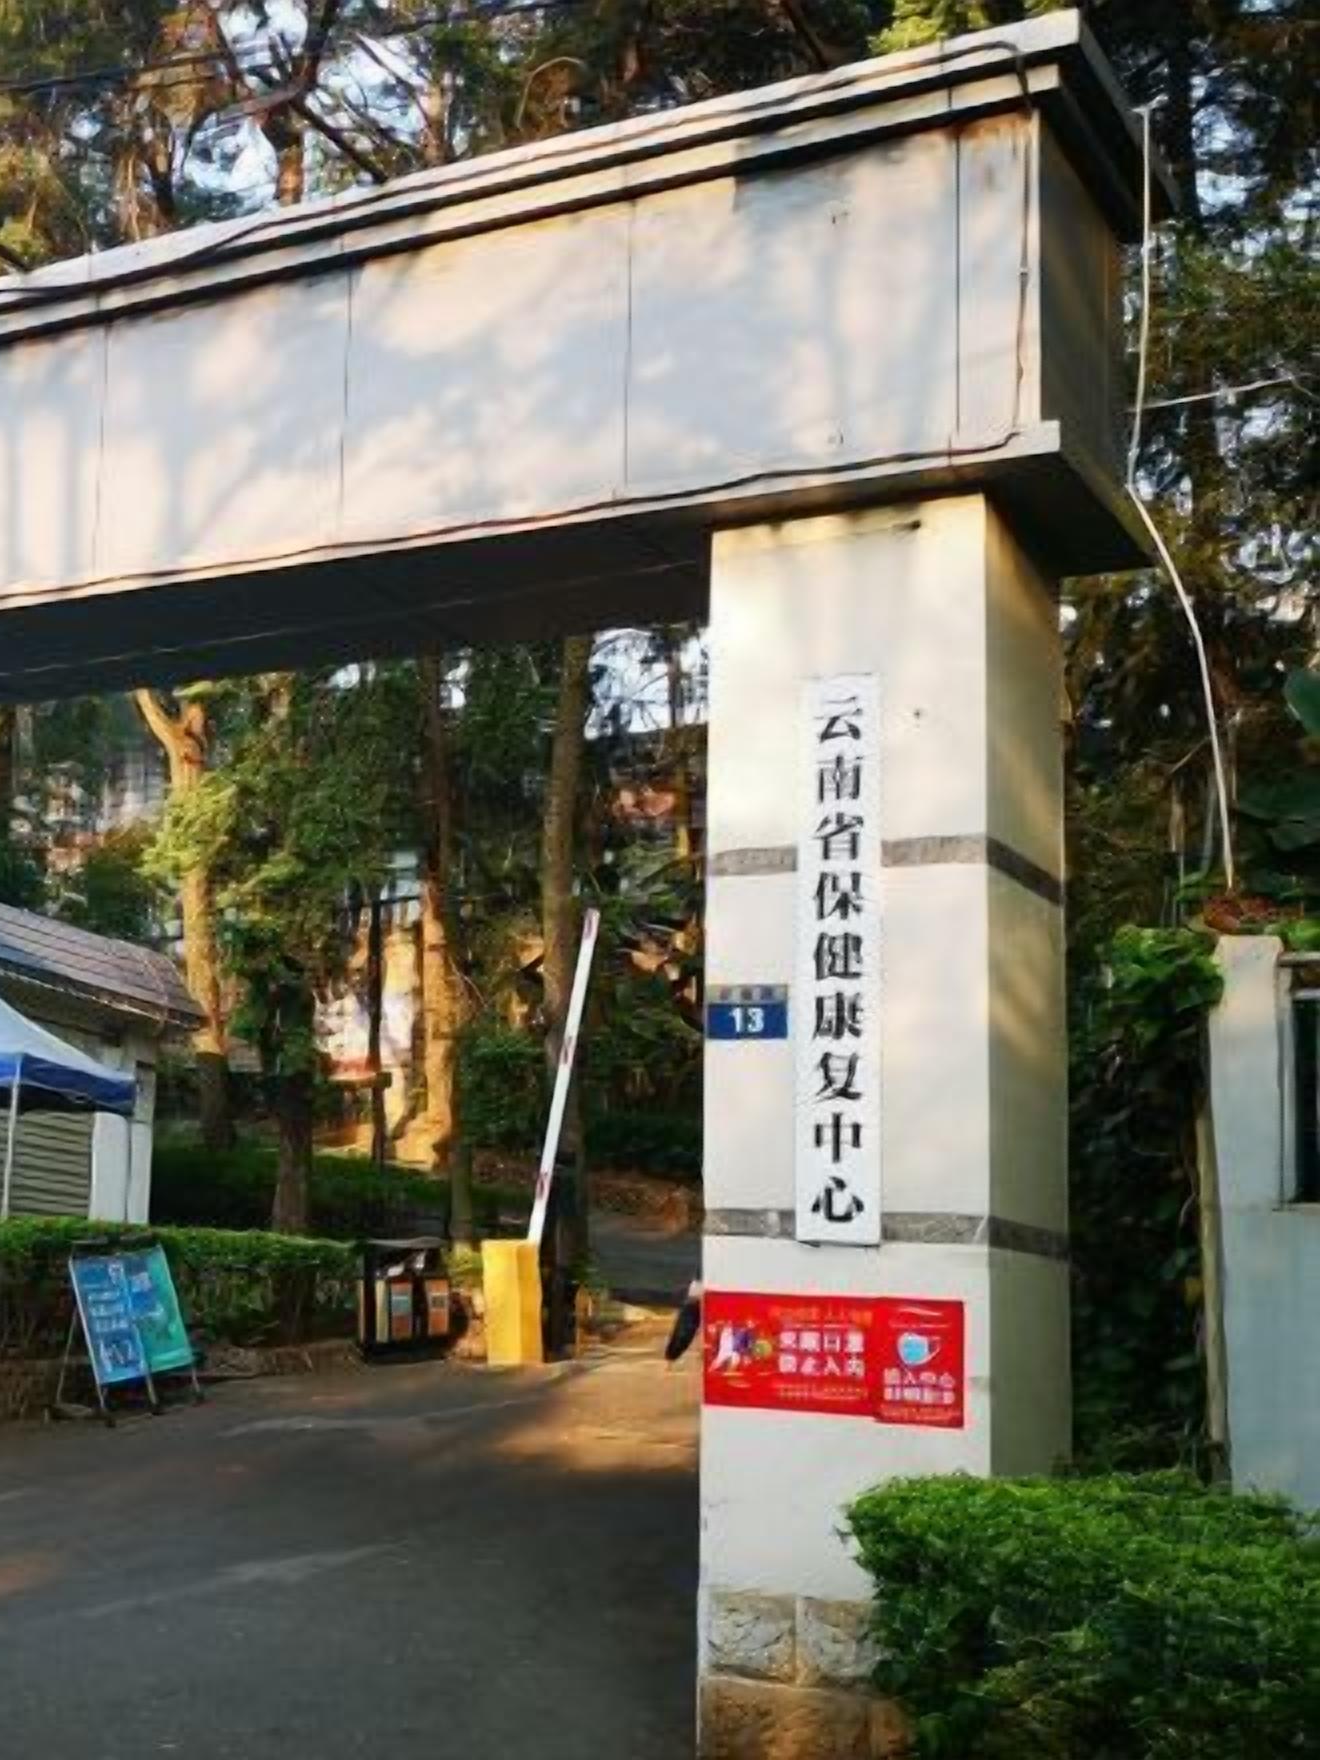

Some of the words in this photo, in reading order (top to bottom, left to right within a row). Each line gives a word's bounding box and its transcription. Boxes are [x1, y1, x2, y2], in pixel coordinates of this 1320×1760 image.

[729, 1010, 764, 1033] 13
[813, 696, 864, 1223] 云南省保健康复中心
